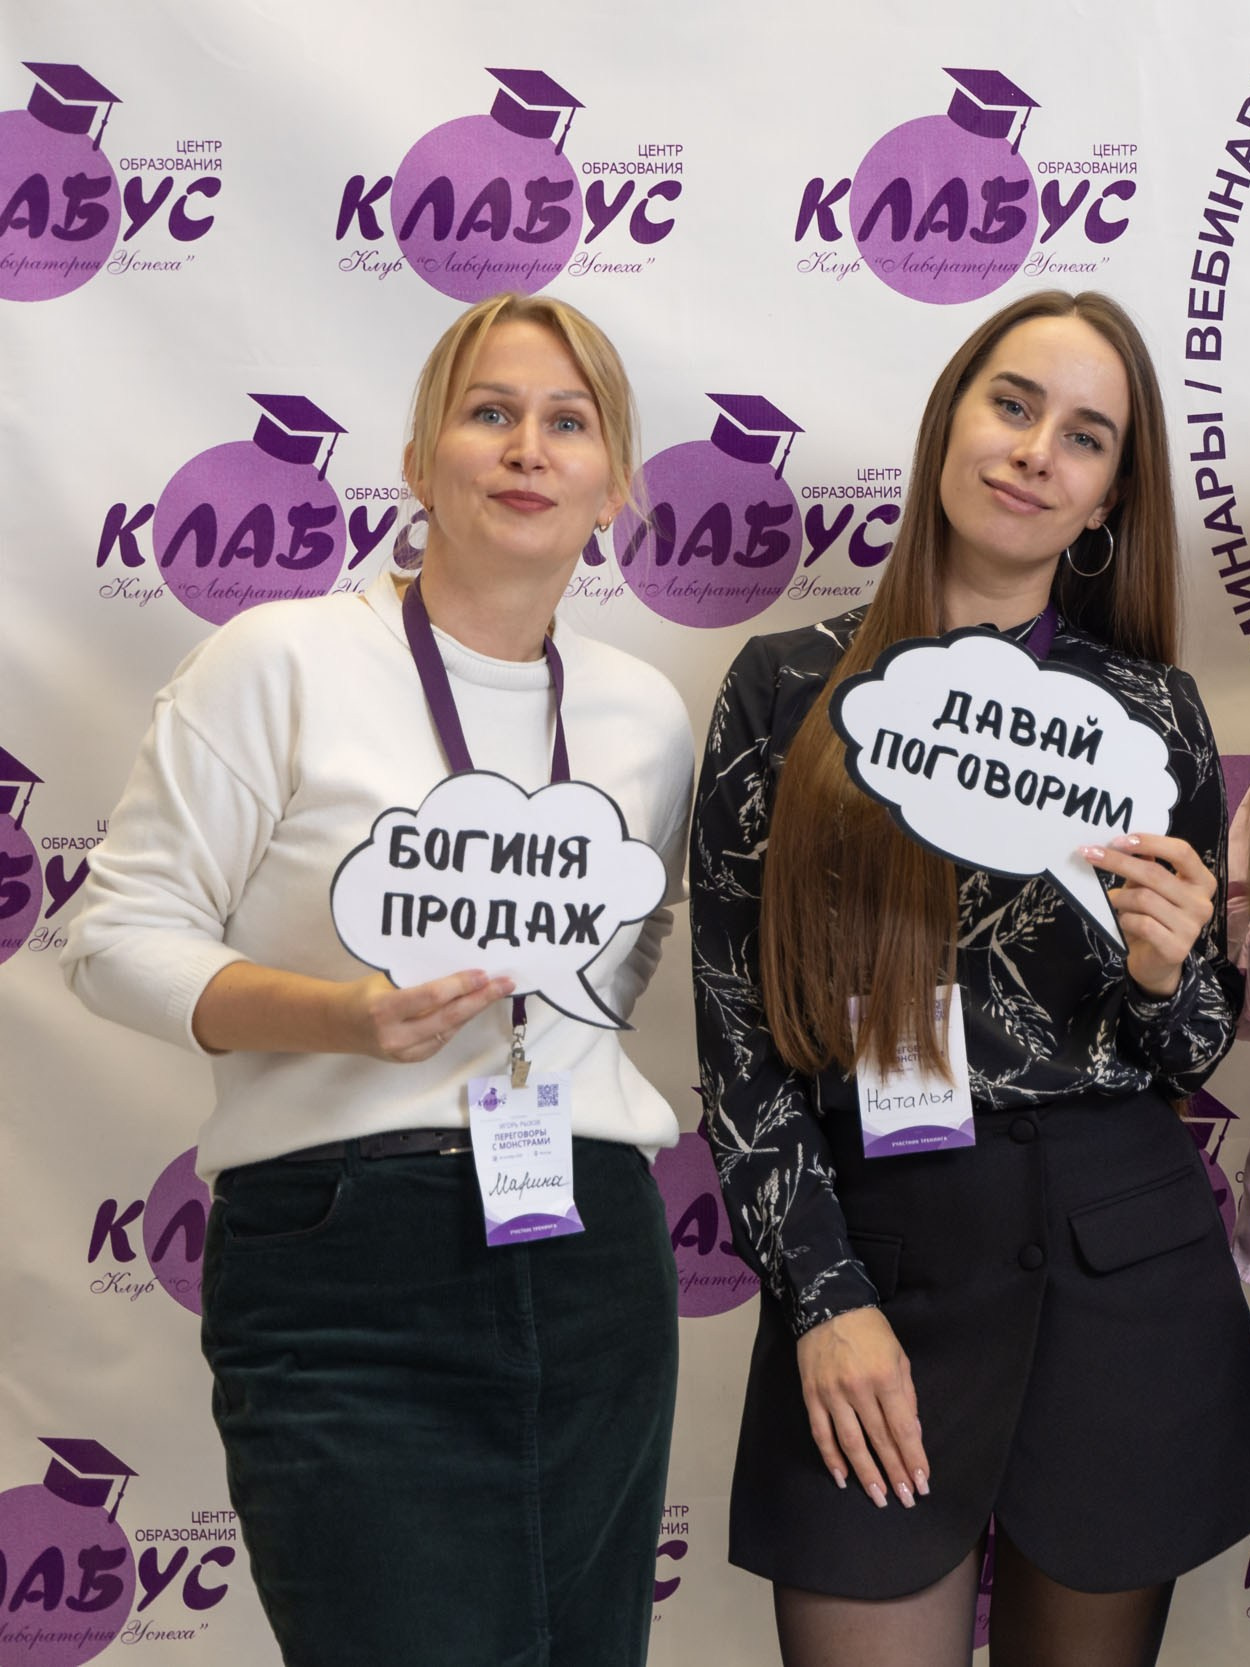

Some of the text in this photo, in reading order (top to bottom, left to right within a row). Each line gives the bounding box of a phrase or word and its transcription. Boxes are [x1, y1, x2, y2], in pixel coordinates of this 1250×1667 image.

[176, 140, 223, 153] ЦЕНТР
[638, 144, 683, 158] ЦЕНТР
[1093, 144, 1138, 158] ЦЕНТР
[119, 158, 223, 171] ОБРАЗОВАНИЯ
[582, 162, 683, 175] ОБРАЗОВАНИЯ
[1037, 161, 1138, 175] ОБРАЗОВАНИЯ
[336, 175, 682, 245] КЛАБУС
[795, 176, 1137, 245] КЛАБУС
[338, 250, 407, 280] Клуб
[796, 251, 865, 281] Клуб
[857, 468, 902, 483] ЦЕНТР
[801, 486, 902, 499] ОБРАЗОВАНИЯ
[99, 577, 169, 607] Клуб
[564, 576, 628, 605] Клуб
[932, 689, 1104, 765] ДАВАЙ
[870, 728, 1133, 834] ПОГОВОРИМ
[389, 825, 592, 879] БОГИНЯ
[381, 892, 606, 950] ПРОДАЖ
[867, 1088, 954, 1113] Наталья
[492, 1137, 551, 1151] С МОНСТРАМИ
[494, 1128, 547, 1141] ПЕРЕГОВОРЫ
[489, 1171, 569, 1200] Марина
[90, 1272, 158, 1302] Клуб
[192, 1511, 236, 1525] ЦЕНТР
[135, 1528, 236, 1541] ОБРАЗОВАНИЯ
[0, 1544, 235, 1612] АБУС
